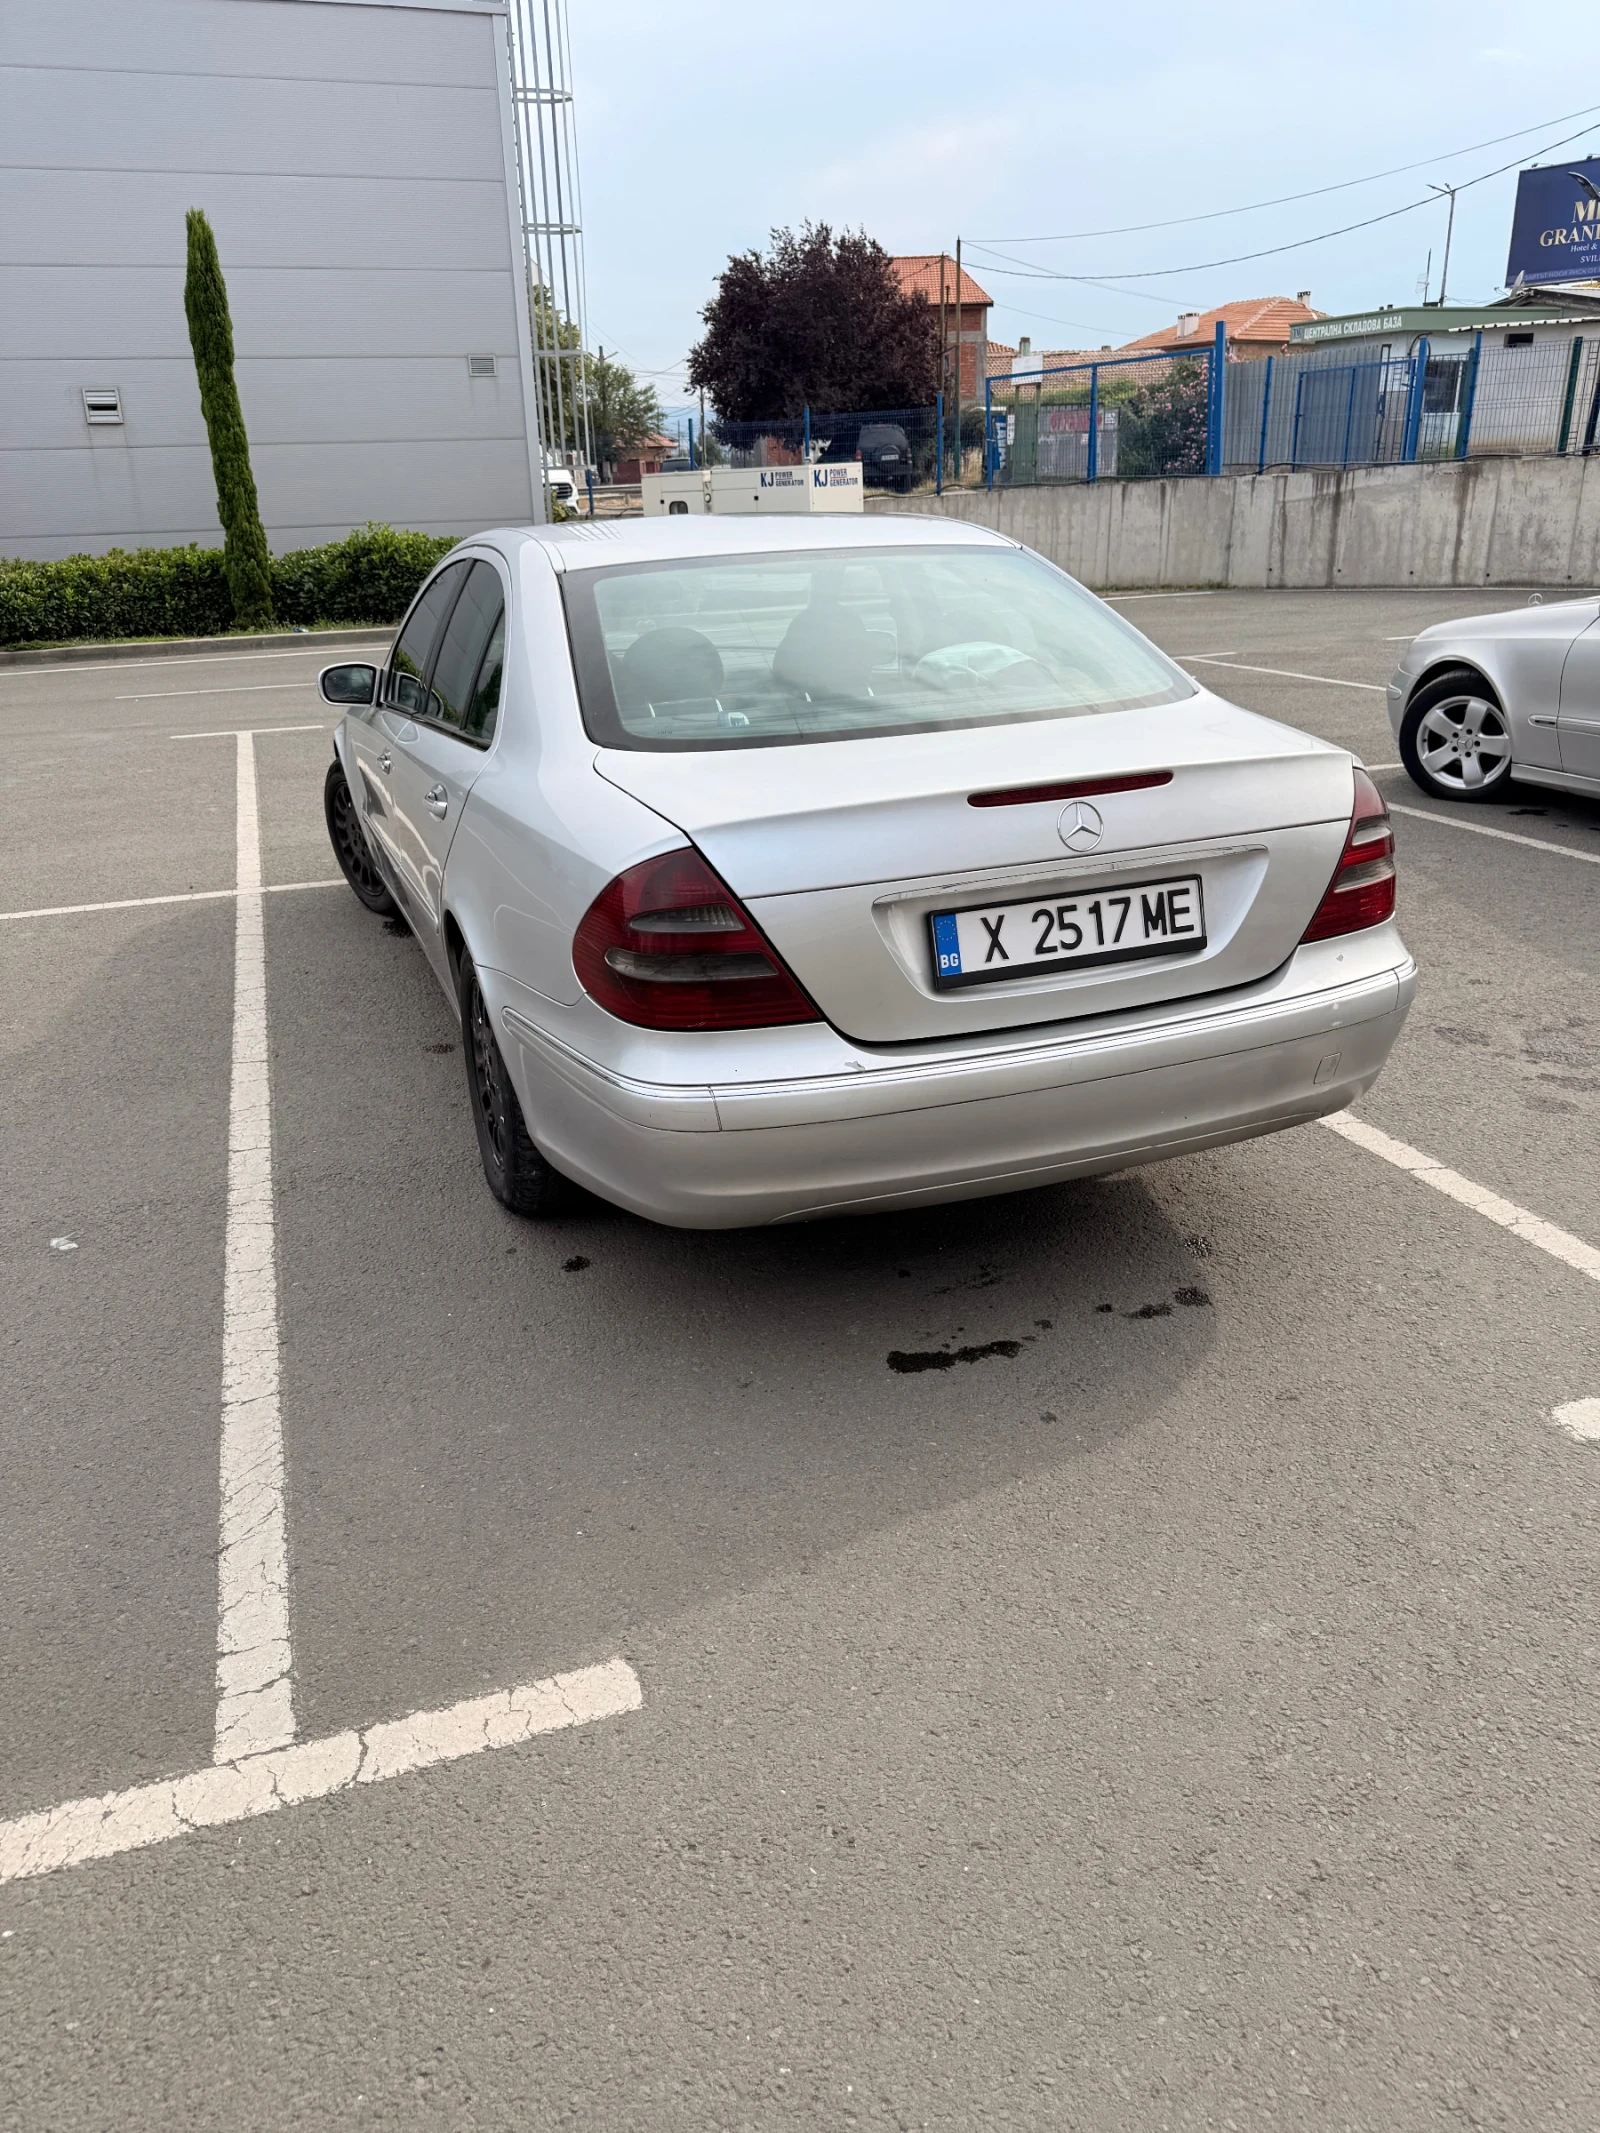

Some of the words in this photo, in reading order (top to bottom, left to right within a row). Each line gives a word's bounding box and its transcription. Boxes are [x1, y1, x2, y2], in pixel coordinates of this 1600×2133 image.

[1571, 199, 1600, 223] M
[1570, 244, 1590, 252] Hotel
[1591, 242, 1597, 250] &
[1580, 254, 1600, 263] SVIL
[1304, 323, 1342, 340] ЦЕНТРАЛНА
[1343, 319, 1381, 334] СКЛАДОВА
[1383, 315, 1402, 329] БАЗА
[775, 471, 793, 479] POWER
[814, 469, 828, 487] KJ
[829, 468, 848, 477] POWER
[760, 472, 774, 487] KJ
[775, 479, 804, 487] GENERATOR
[829, 478, 858, 487] GENERATOR
[1031, 896, 1132, 955] 2517
[1141, 888, 1195, 938] ME
[940, 953, 959, 968] BG
